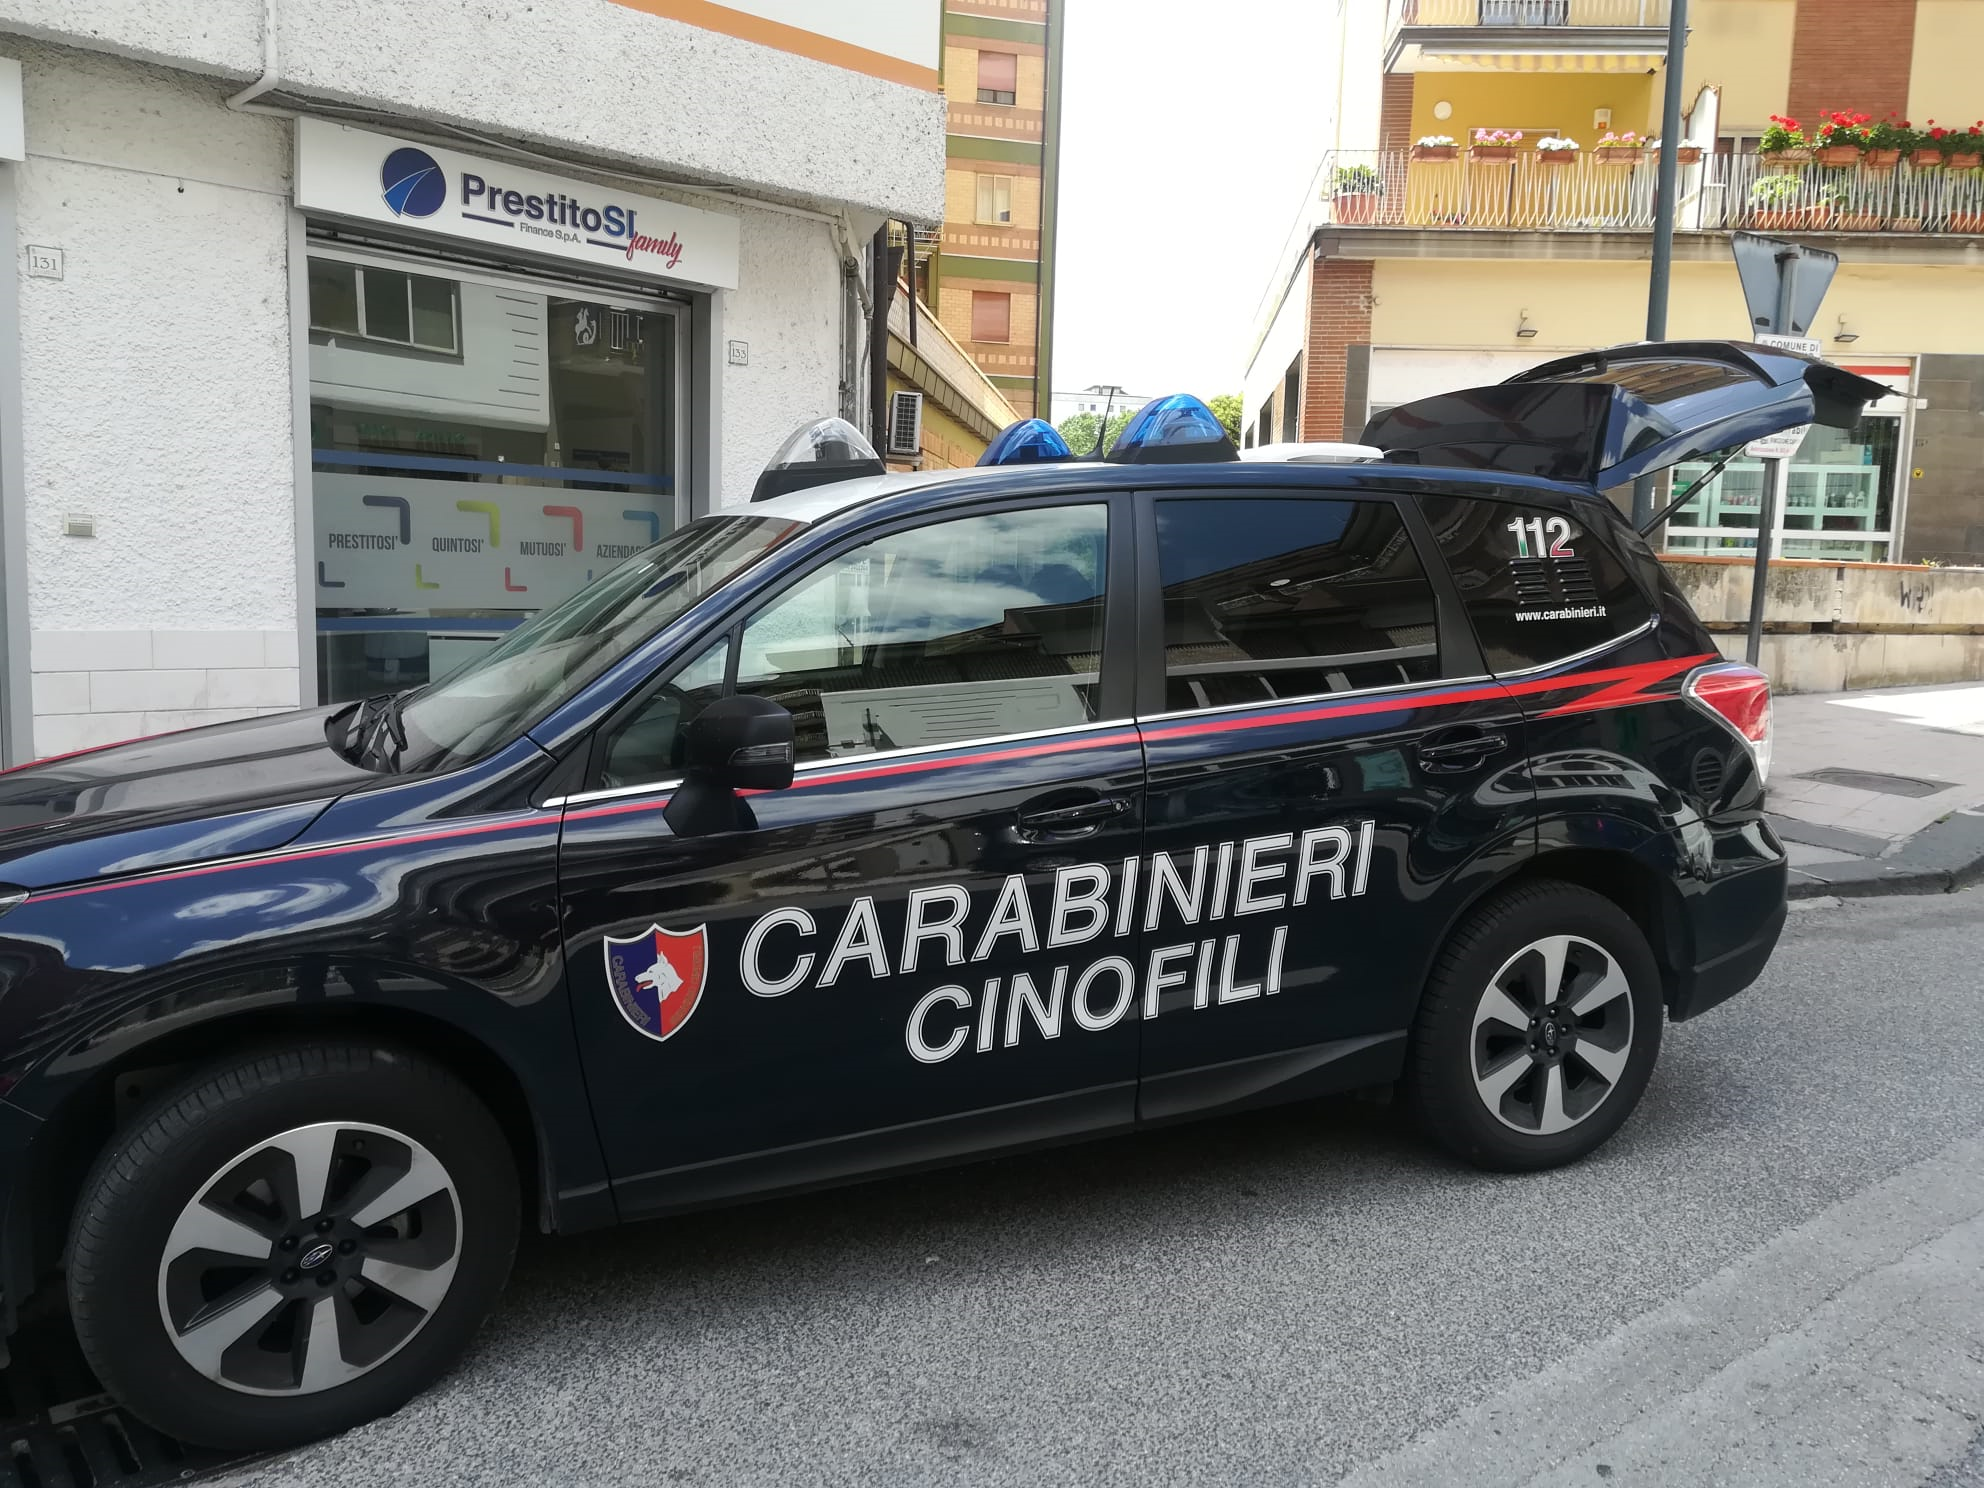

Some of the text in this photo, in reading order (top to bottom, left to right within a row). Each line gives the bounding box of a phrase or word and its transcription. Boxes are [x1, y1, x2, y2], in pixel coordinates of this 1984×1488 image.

[461, 172, 635, 240] PrestitoSI
[519, 221, 582, 243] Finance S.p.A.
[626, 231, 683, 270] family
[32, 255, 57, 270] 131
[1770, 340, 1819, 353] COMUNE DI
[1507, 516, 1575, 559] 112
[1515, 606, 1607, 621] www.carabinieri.it
[739, 820, 1376, 998] CARABINIERI
[906, 925, 1289, 1064] CINOFILI
